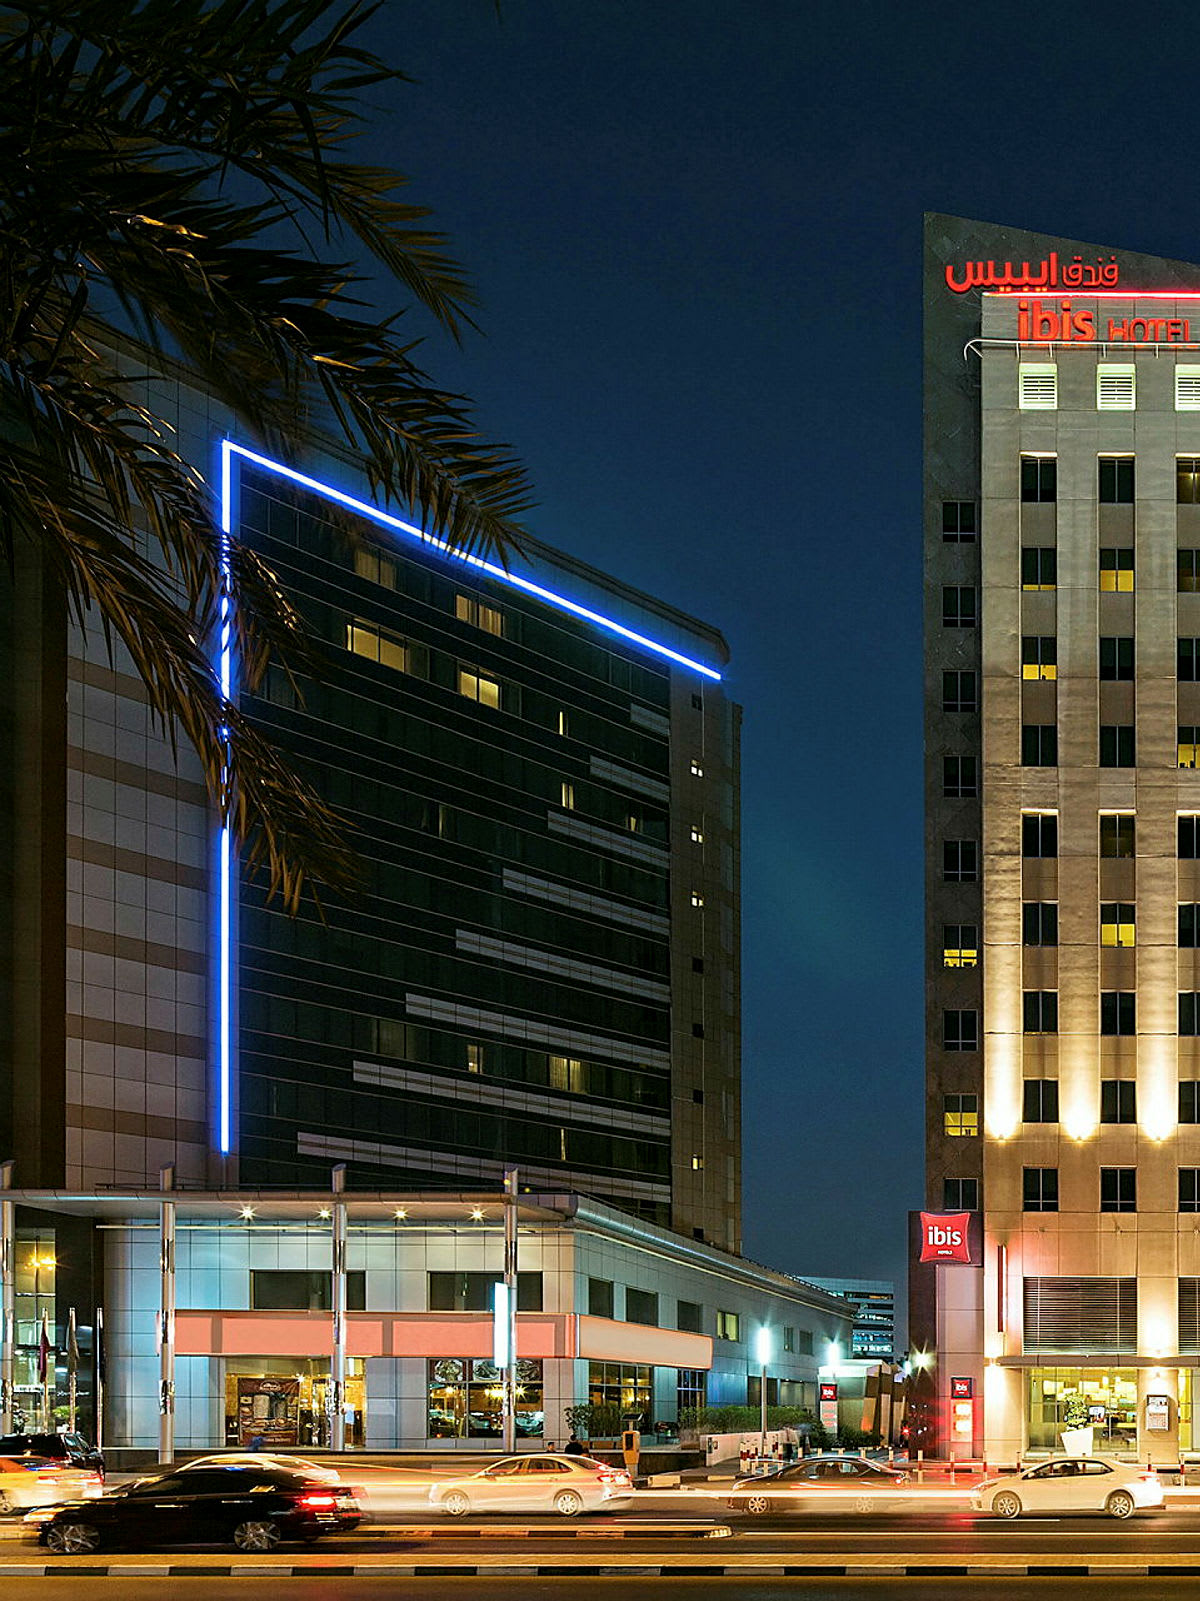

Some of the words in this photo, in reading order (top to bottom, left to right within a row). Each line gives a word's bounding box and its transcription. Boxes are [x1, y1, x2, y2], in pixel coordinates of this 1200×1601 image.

[1062, 256, 1119, 287] فندق
[1018, 300, 1096, 347] ibis
[1108, 318, 1197, 347] HOTEL
[928, 1226, 962, 1245] ibis
